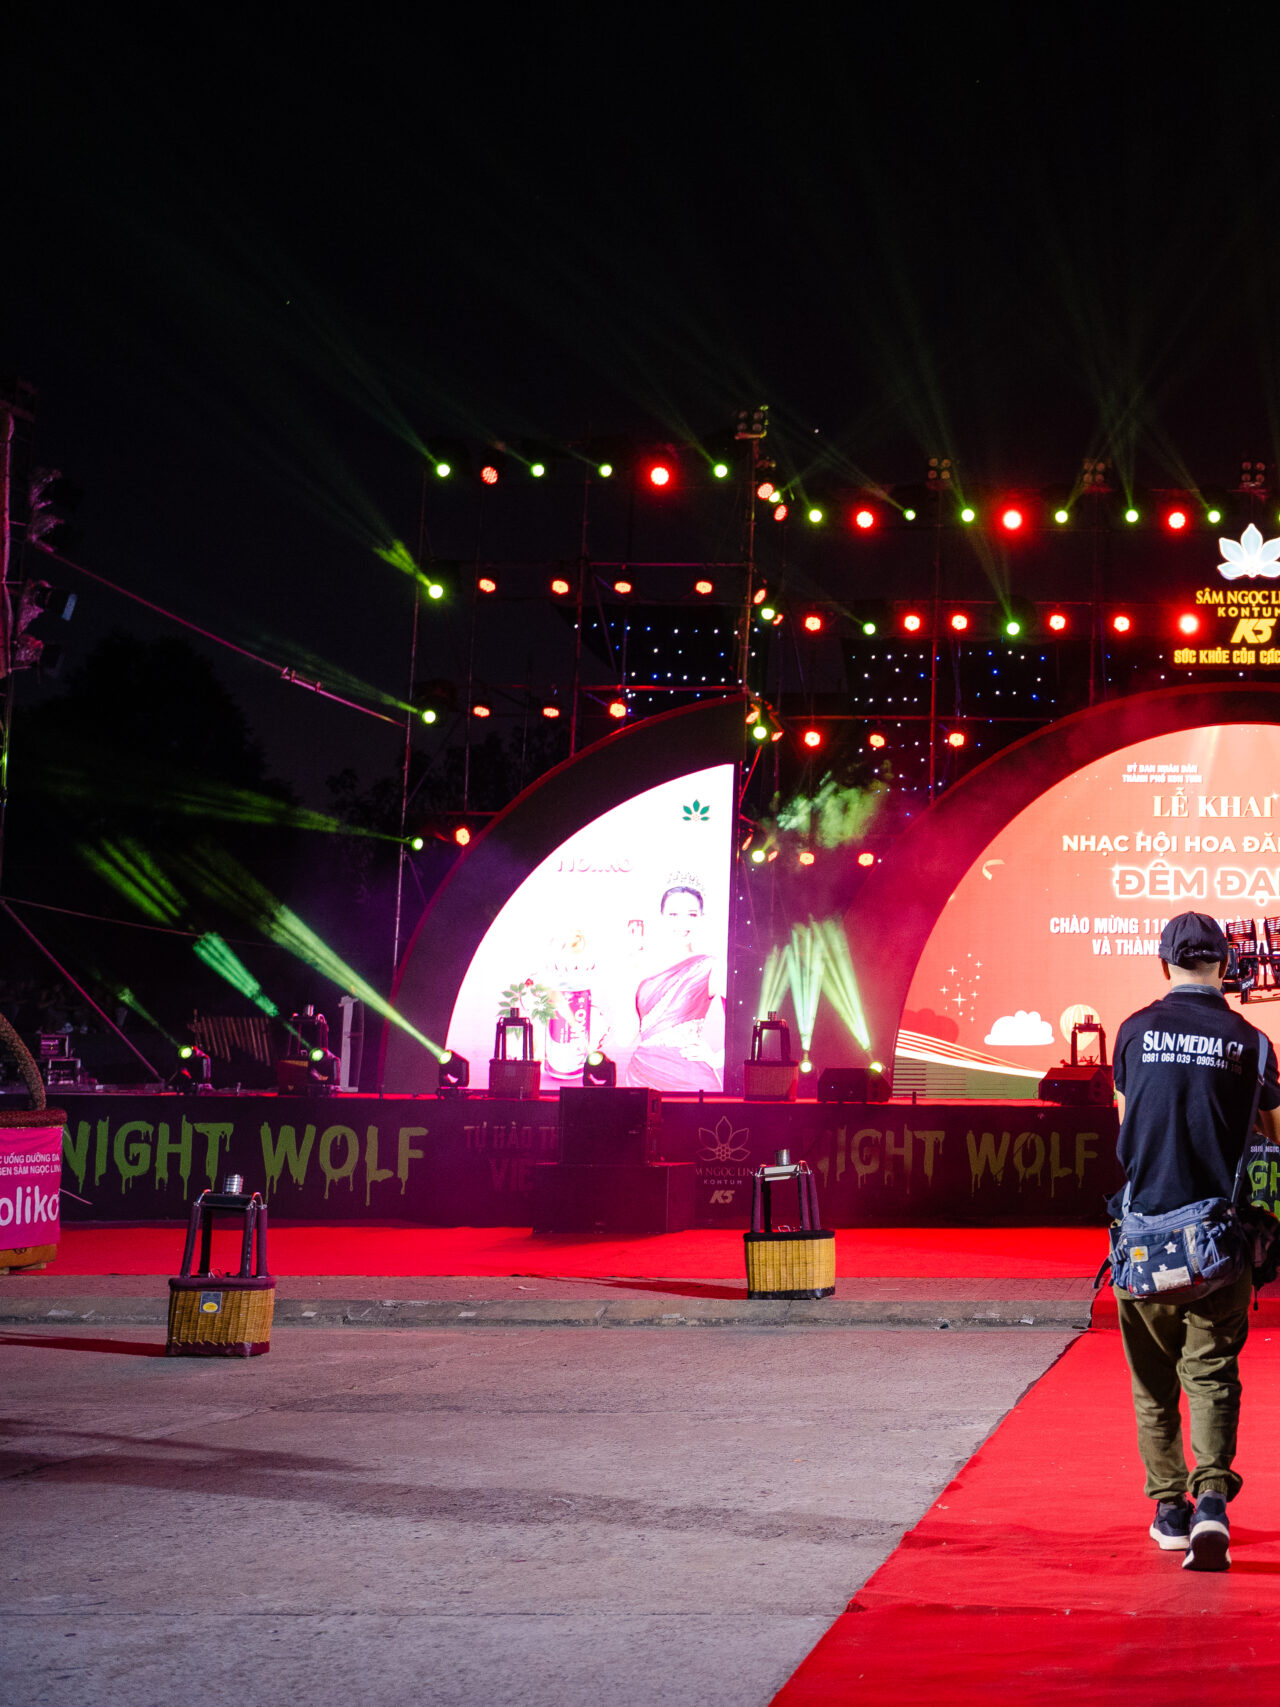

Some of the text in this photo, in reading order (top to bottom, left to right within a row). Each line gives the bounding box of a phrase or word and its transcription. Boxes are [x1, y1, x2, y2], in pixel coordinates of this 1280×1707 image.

[1196, 588, 1224, 604] SÂM
[1227, 590, 1268, 606] NGỌC
[1230, 618, 1277, 643] K5
[1174, 648, 1196, 664] SỨC
[1232, 647, 1256, 665] CỦA
[1152, 787, 1188, 818] LỄ
[1198, 796, 1272, 818] KHAI
[1062, 835, 1130, 856] NHẠC
[1135, 831, 1178, 856] HỘI
[1184, 836, 1236, 853] HOA
[1114, 860, 1206, 898] ĐÊM
[1050, 915, 1090, 934] CHÀO
[1094, 915, 1139, 934] MỪNG
[1092, 936, 1111, 955] VÀ
[1142, 1053, 1159, 1063] 0981
[1161, 1053, 1175, 1063] 068
[1176, 1054, 1191, 1064] 039
[62, 1114, 428, 1206] NIGHT WOLF
[966, 1129, 1100, 1198] WOLF
